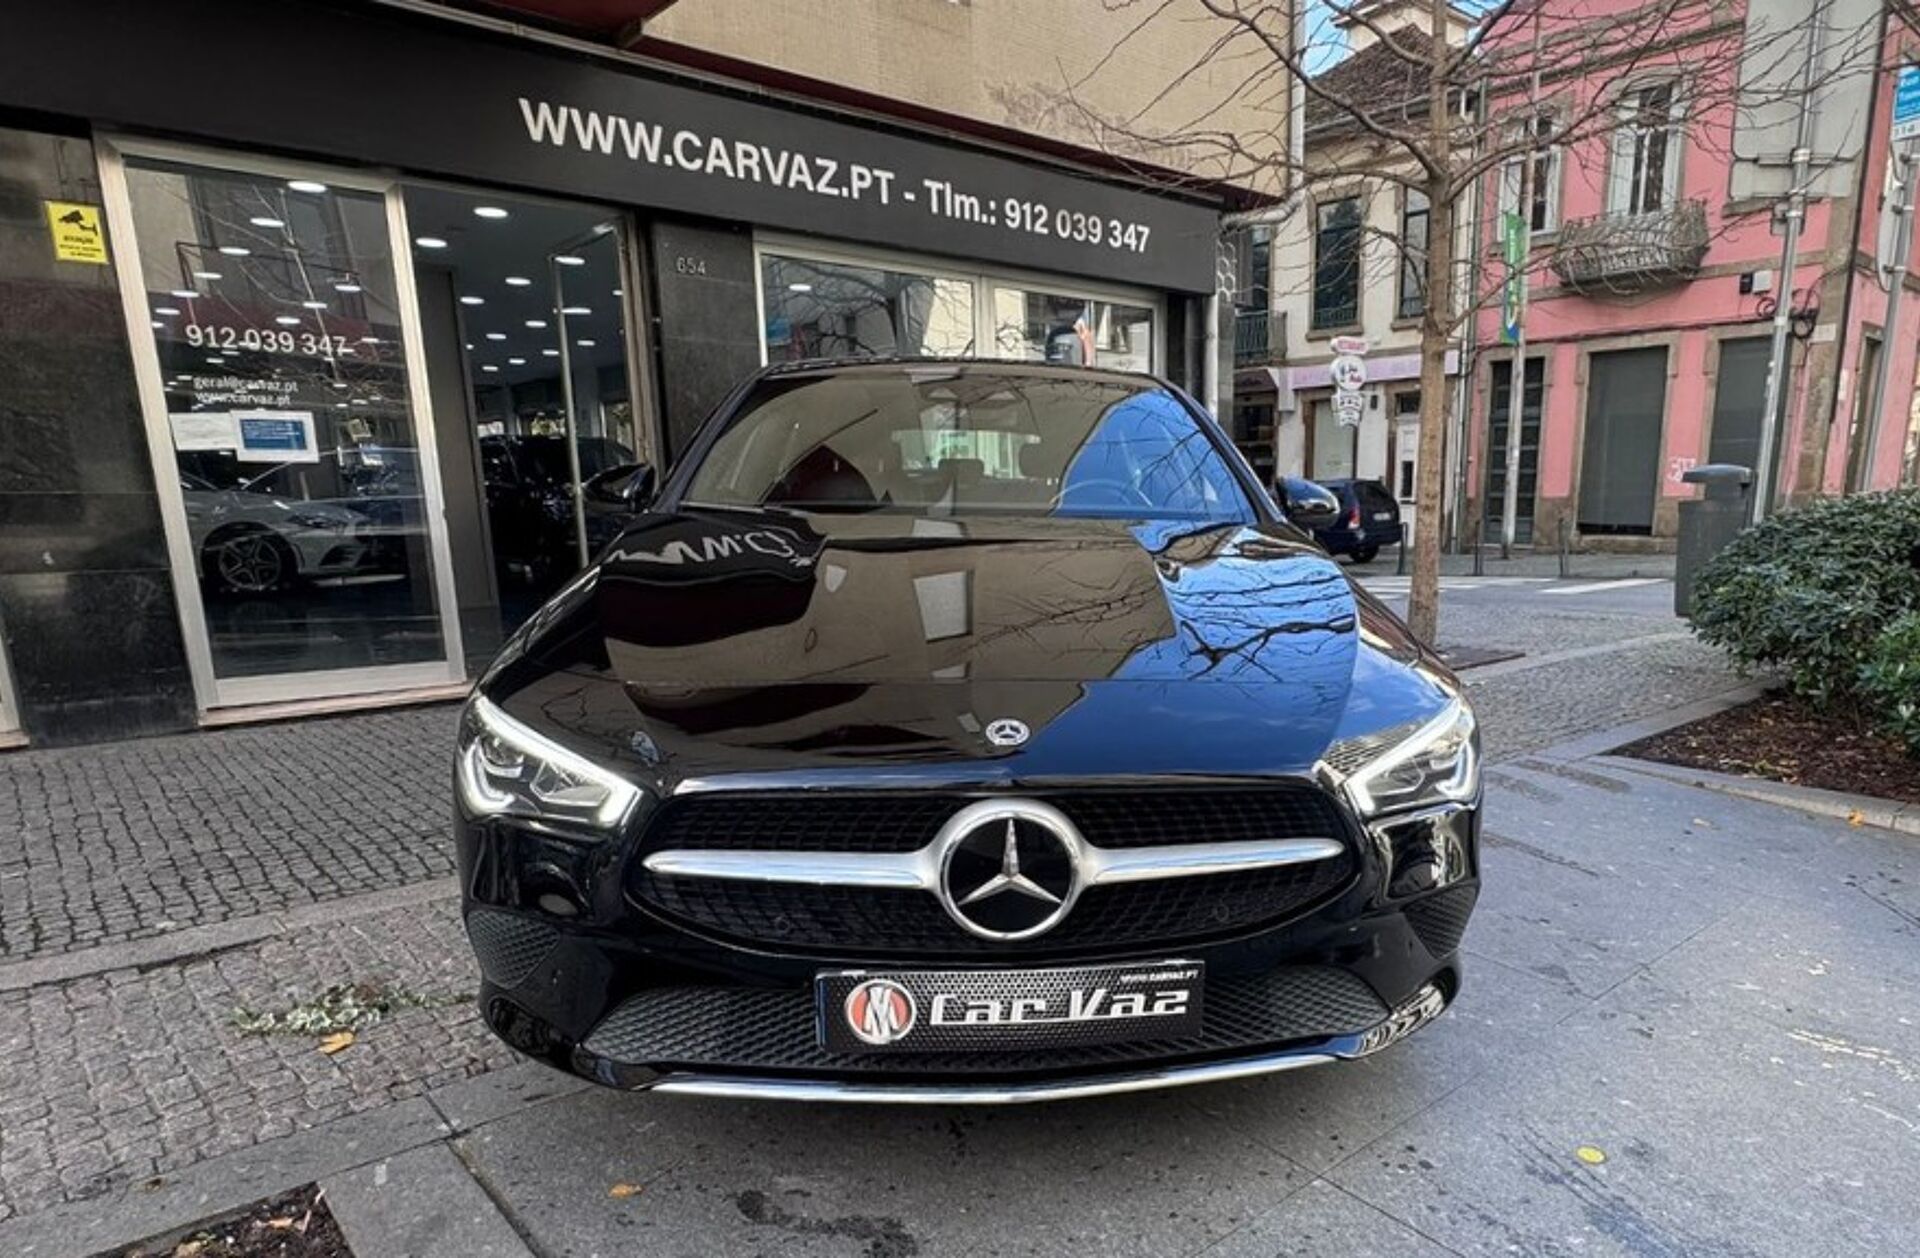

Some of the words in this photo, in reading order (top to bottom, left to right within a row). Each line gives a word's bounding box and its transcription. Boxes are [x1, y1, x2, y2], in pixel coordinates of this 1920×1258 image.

[518, 98, 894, 204] WWW.CARVAZ.PT
[904, 191, 915, 201] -
[923, 179, 996, 225] Tlm.:
[1004, 198, 1048, 234] 912
[1055, 209, 1102, 244] 039
[1108, 219, 1150, 253] 347
[677, 257, 705, 274] 654
[185, 324, 237, 348] 912
[244, 329, 294, 352] 039
[301, 333, 346, 357] 347
[193, 375, 298, 393] geral@carvaz.pt
[195, 391, 290, 407] www.carvaz.pt
[930, 991, 1046, 1025] Car
[1066, 988, 1190, 1020] Vaz
